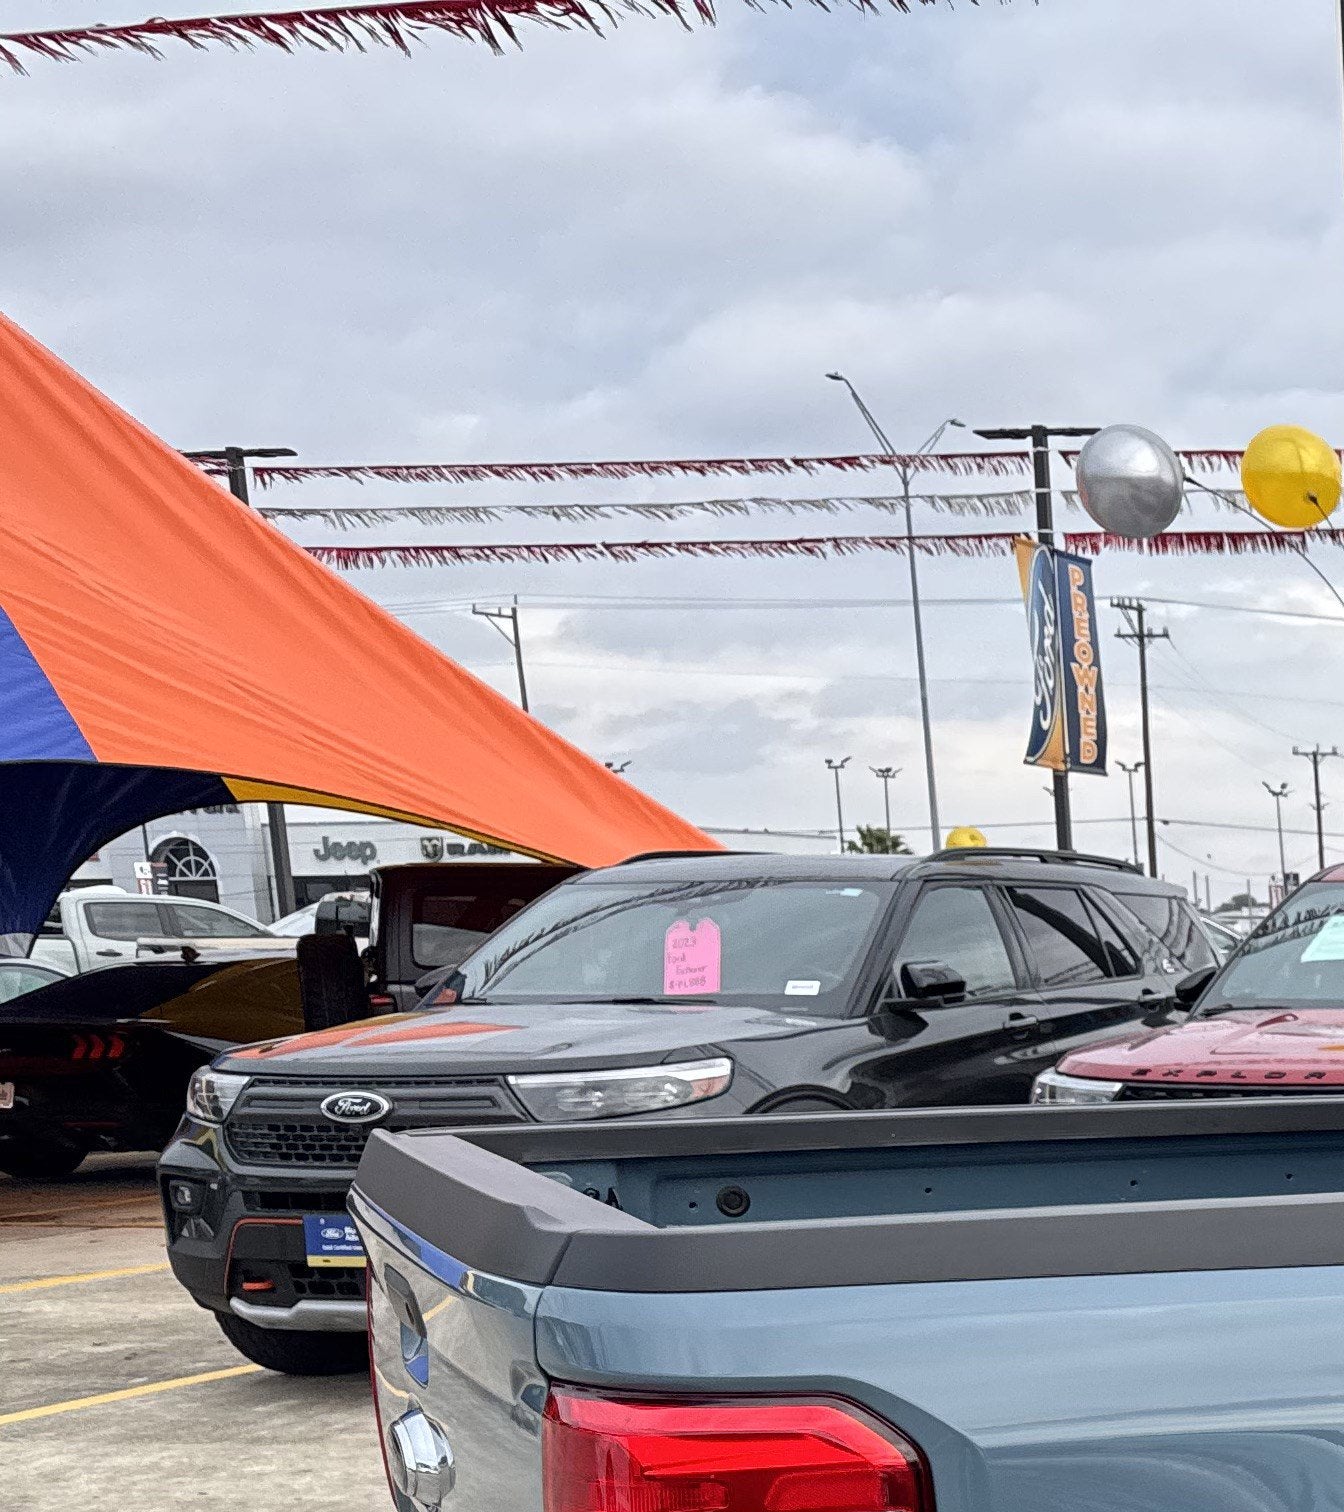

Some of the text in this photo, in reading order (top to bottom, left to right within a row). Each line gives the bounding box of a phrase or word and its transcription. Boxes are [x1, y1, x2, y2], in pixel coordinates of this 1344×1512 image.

[1067, 563, 1098, 765] PREOWNED
[313, 835, 377, 866] Jeep
[334, 1097, 371, 1116] Ford
